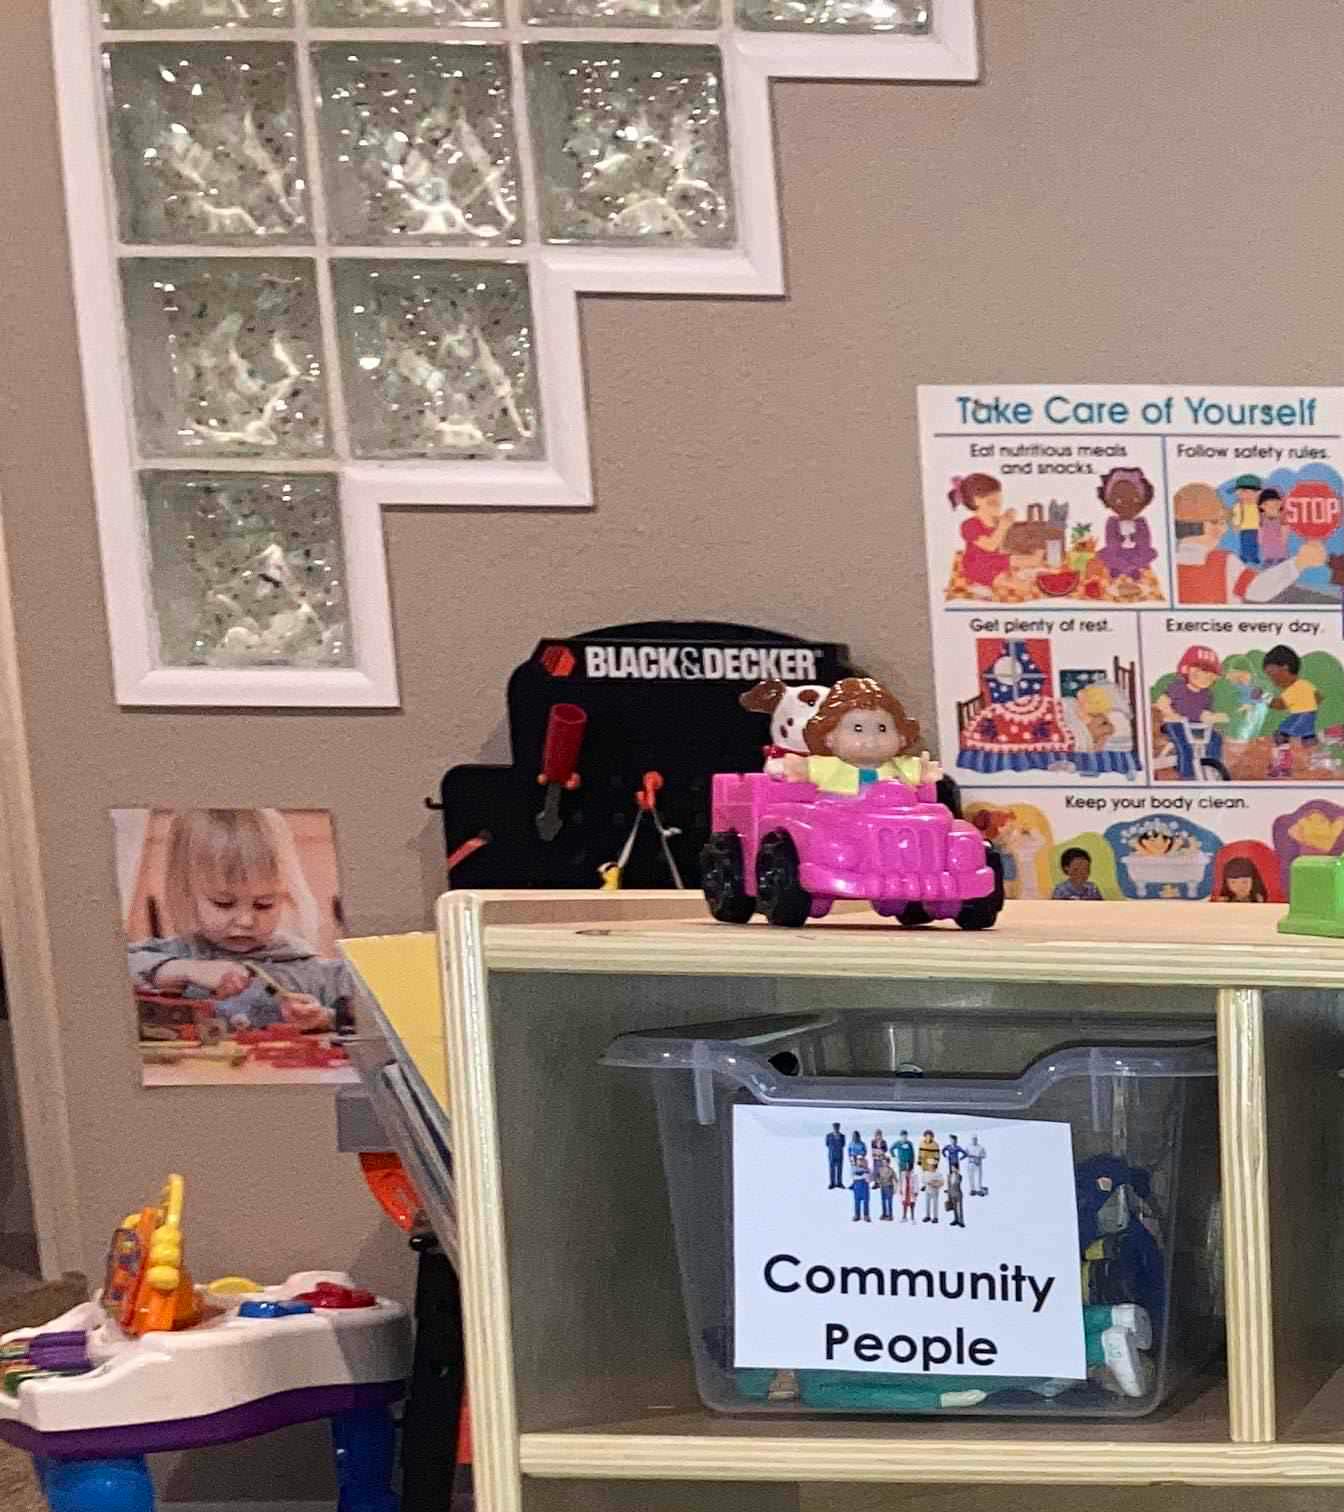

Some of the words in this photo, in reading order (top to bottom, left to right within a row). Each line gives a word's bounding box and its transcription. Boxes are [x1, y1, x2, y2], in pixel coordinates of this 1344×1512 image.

[957, 397, 1033, 424] Take
[1045, 397, 1129, 424] Care
[1143, 398, 1174, 425] of
[1184, 397, 1317, 426] Yourself
[970, 444, 995, 457] Eat
[1000, 444, 1072, 458] nutritious
[1078, 445, 1127, 458] meals
[1178, 444, 1228, 458] Follow
[1234, 445, 1283, 461] safety
[1001, 462, 1033, 475] and
[1284, 495, 1339, 525] STOP
[970, 618, 999, 633] Get
[1005, 618, 1053, 636] plenty
[1059, 618, 1075, 633] of
[1166, 618, 1232, 633] Exercise
[1238, 621, 1283, 636] every
[1065, 795, 1106, 811] Keep
[1111, 797, 1146, 811] your
[1151, 796, 1192, 811] body
[1199, 796, 1249, 808] clean.
[763, 1254, 1056, 1312] Community
[825, 1323, 998, 1371] People
